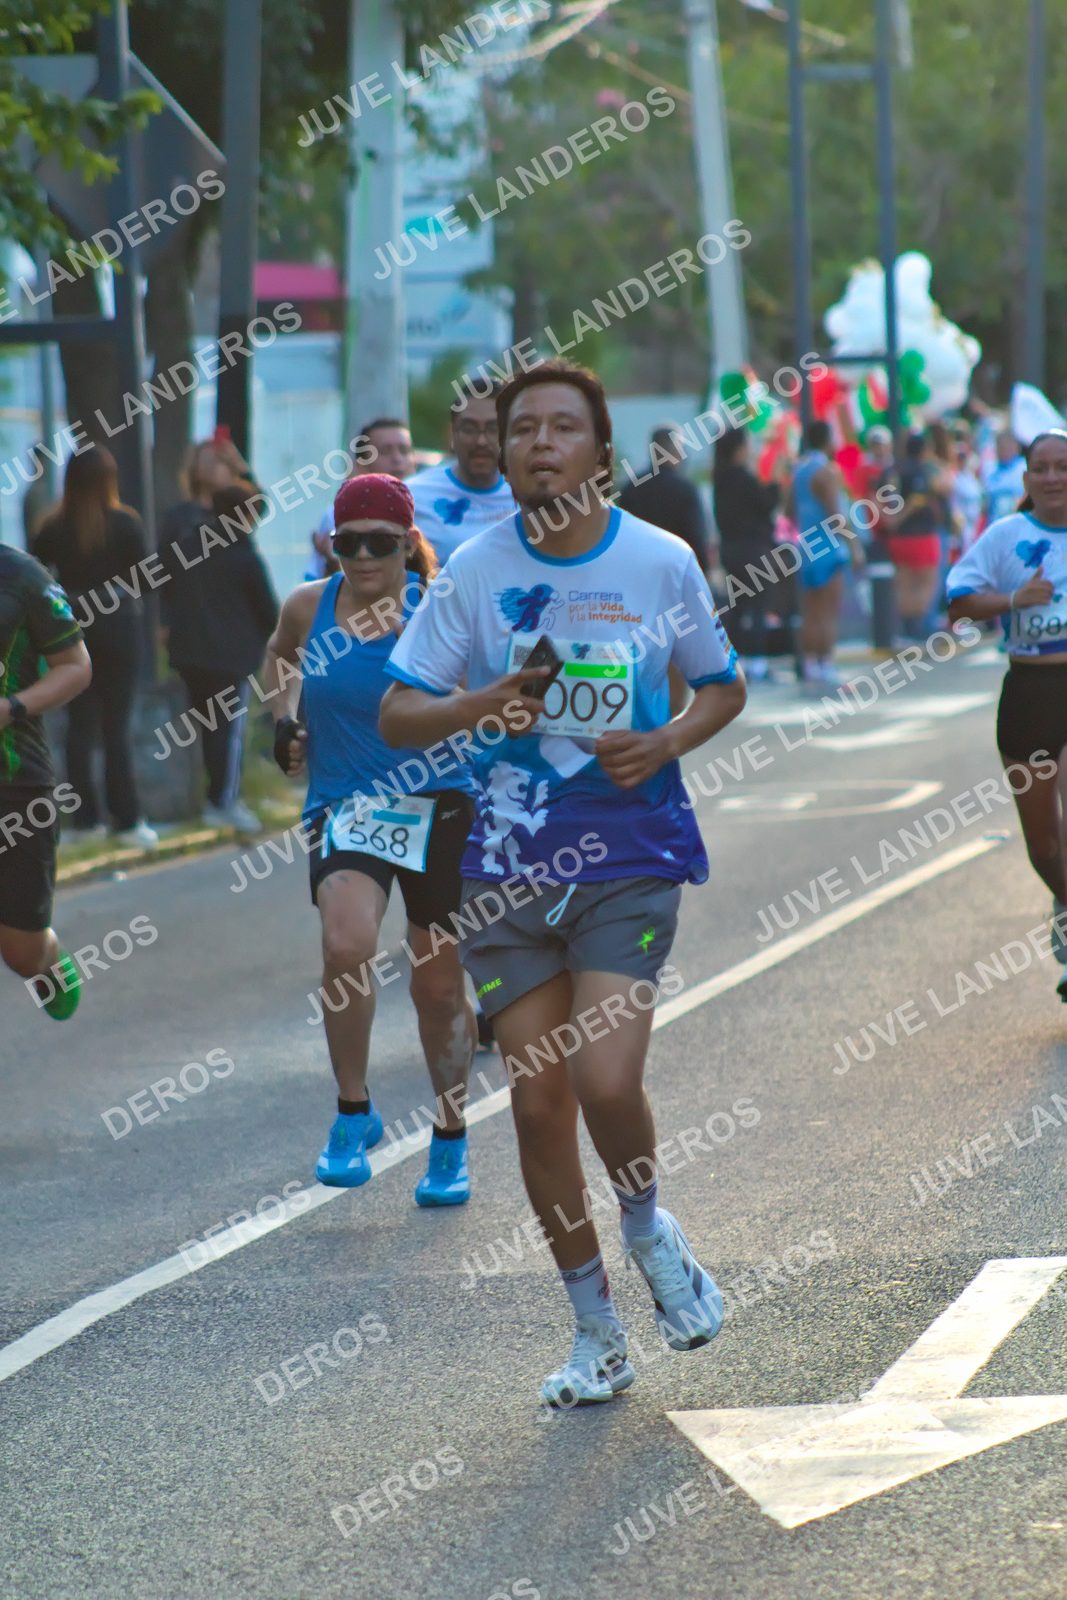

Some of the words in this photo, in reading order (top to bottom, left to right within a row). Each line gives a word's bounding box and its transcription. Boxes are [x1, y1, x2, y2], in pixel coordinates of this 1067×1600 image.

[568, 590, 623, 602] Carrera
[600, 602, 625, 612] Vida
[588, 612, 642, 624] Integridad
[349, 821, 410, 859] 568
